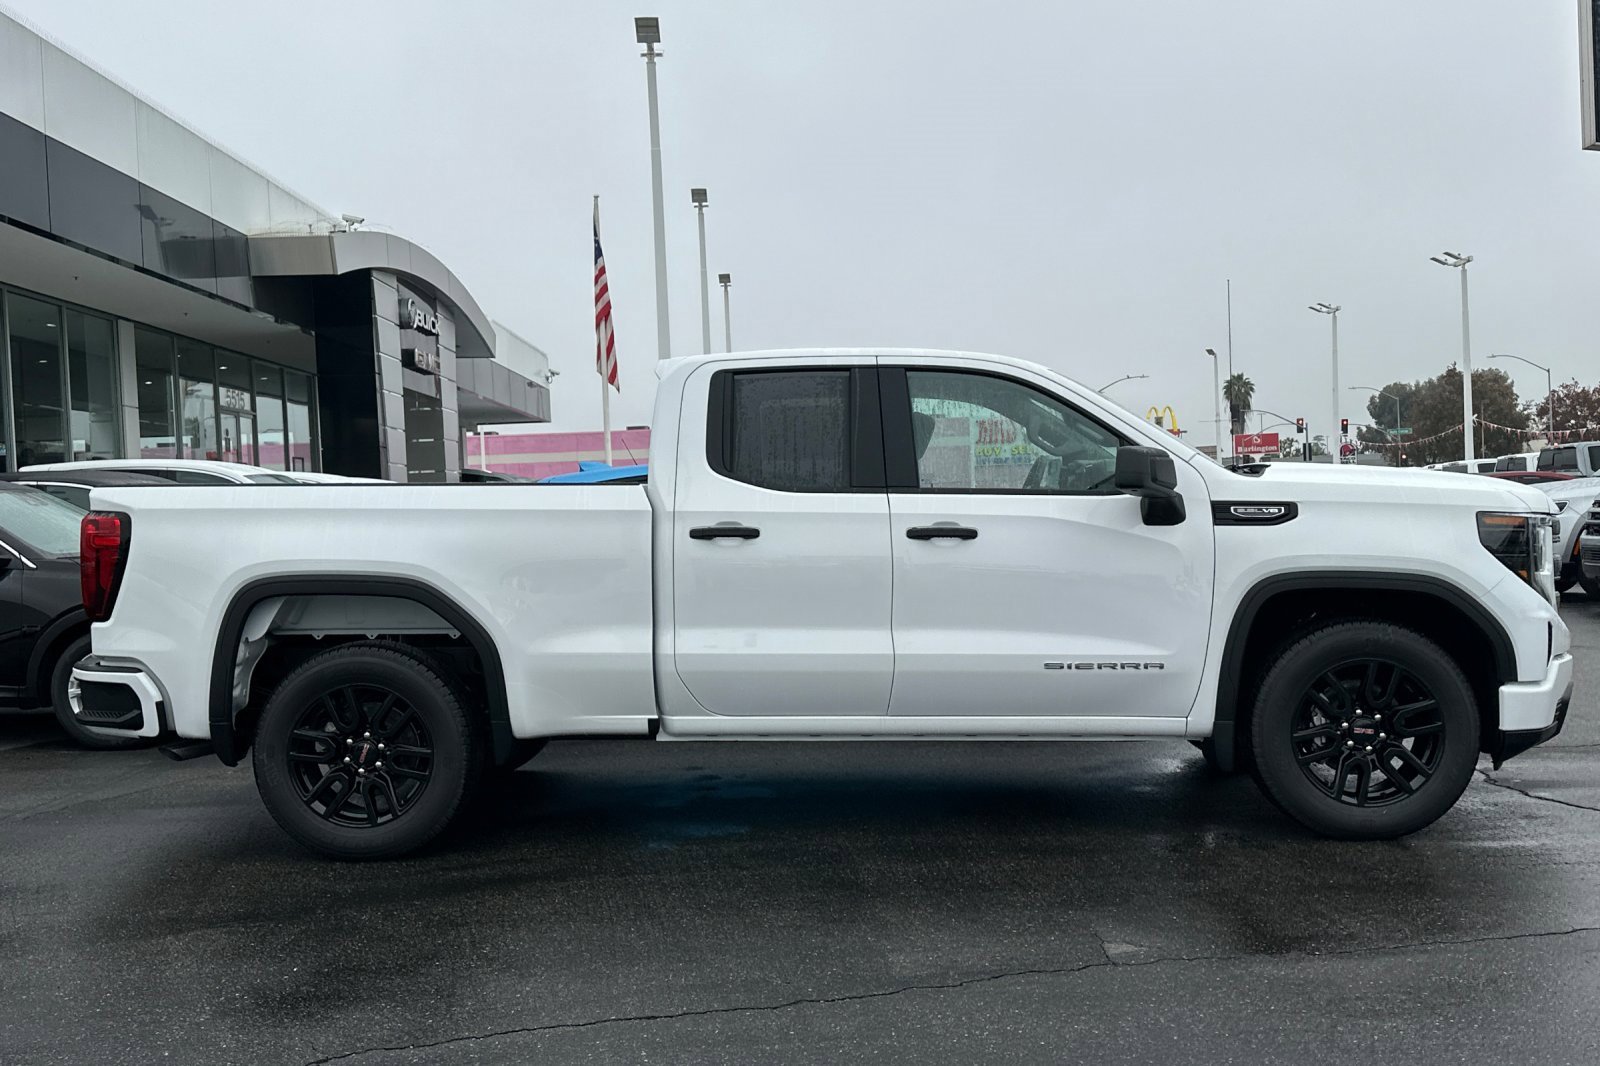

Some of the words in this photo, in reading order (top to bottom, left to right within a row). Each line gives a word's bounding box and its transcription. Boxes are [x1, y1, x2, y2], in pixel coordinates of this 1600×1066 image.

[415, 309, 441, 335] BUICK
[226, 389, 245, 410] 5515
[1011, 444, 1035, 456] SEL
[1237, 445, 1278, 453] Burlington
[1043, 662, 1165, 671] SIERRA
